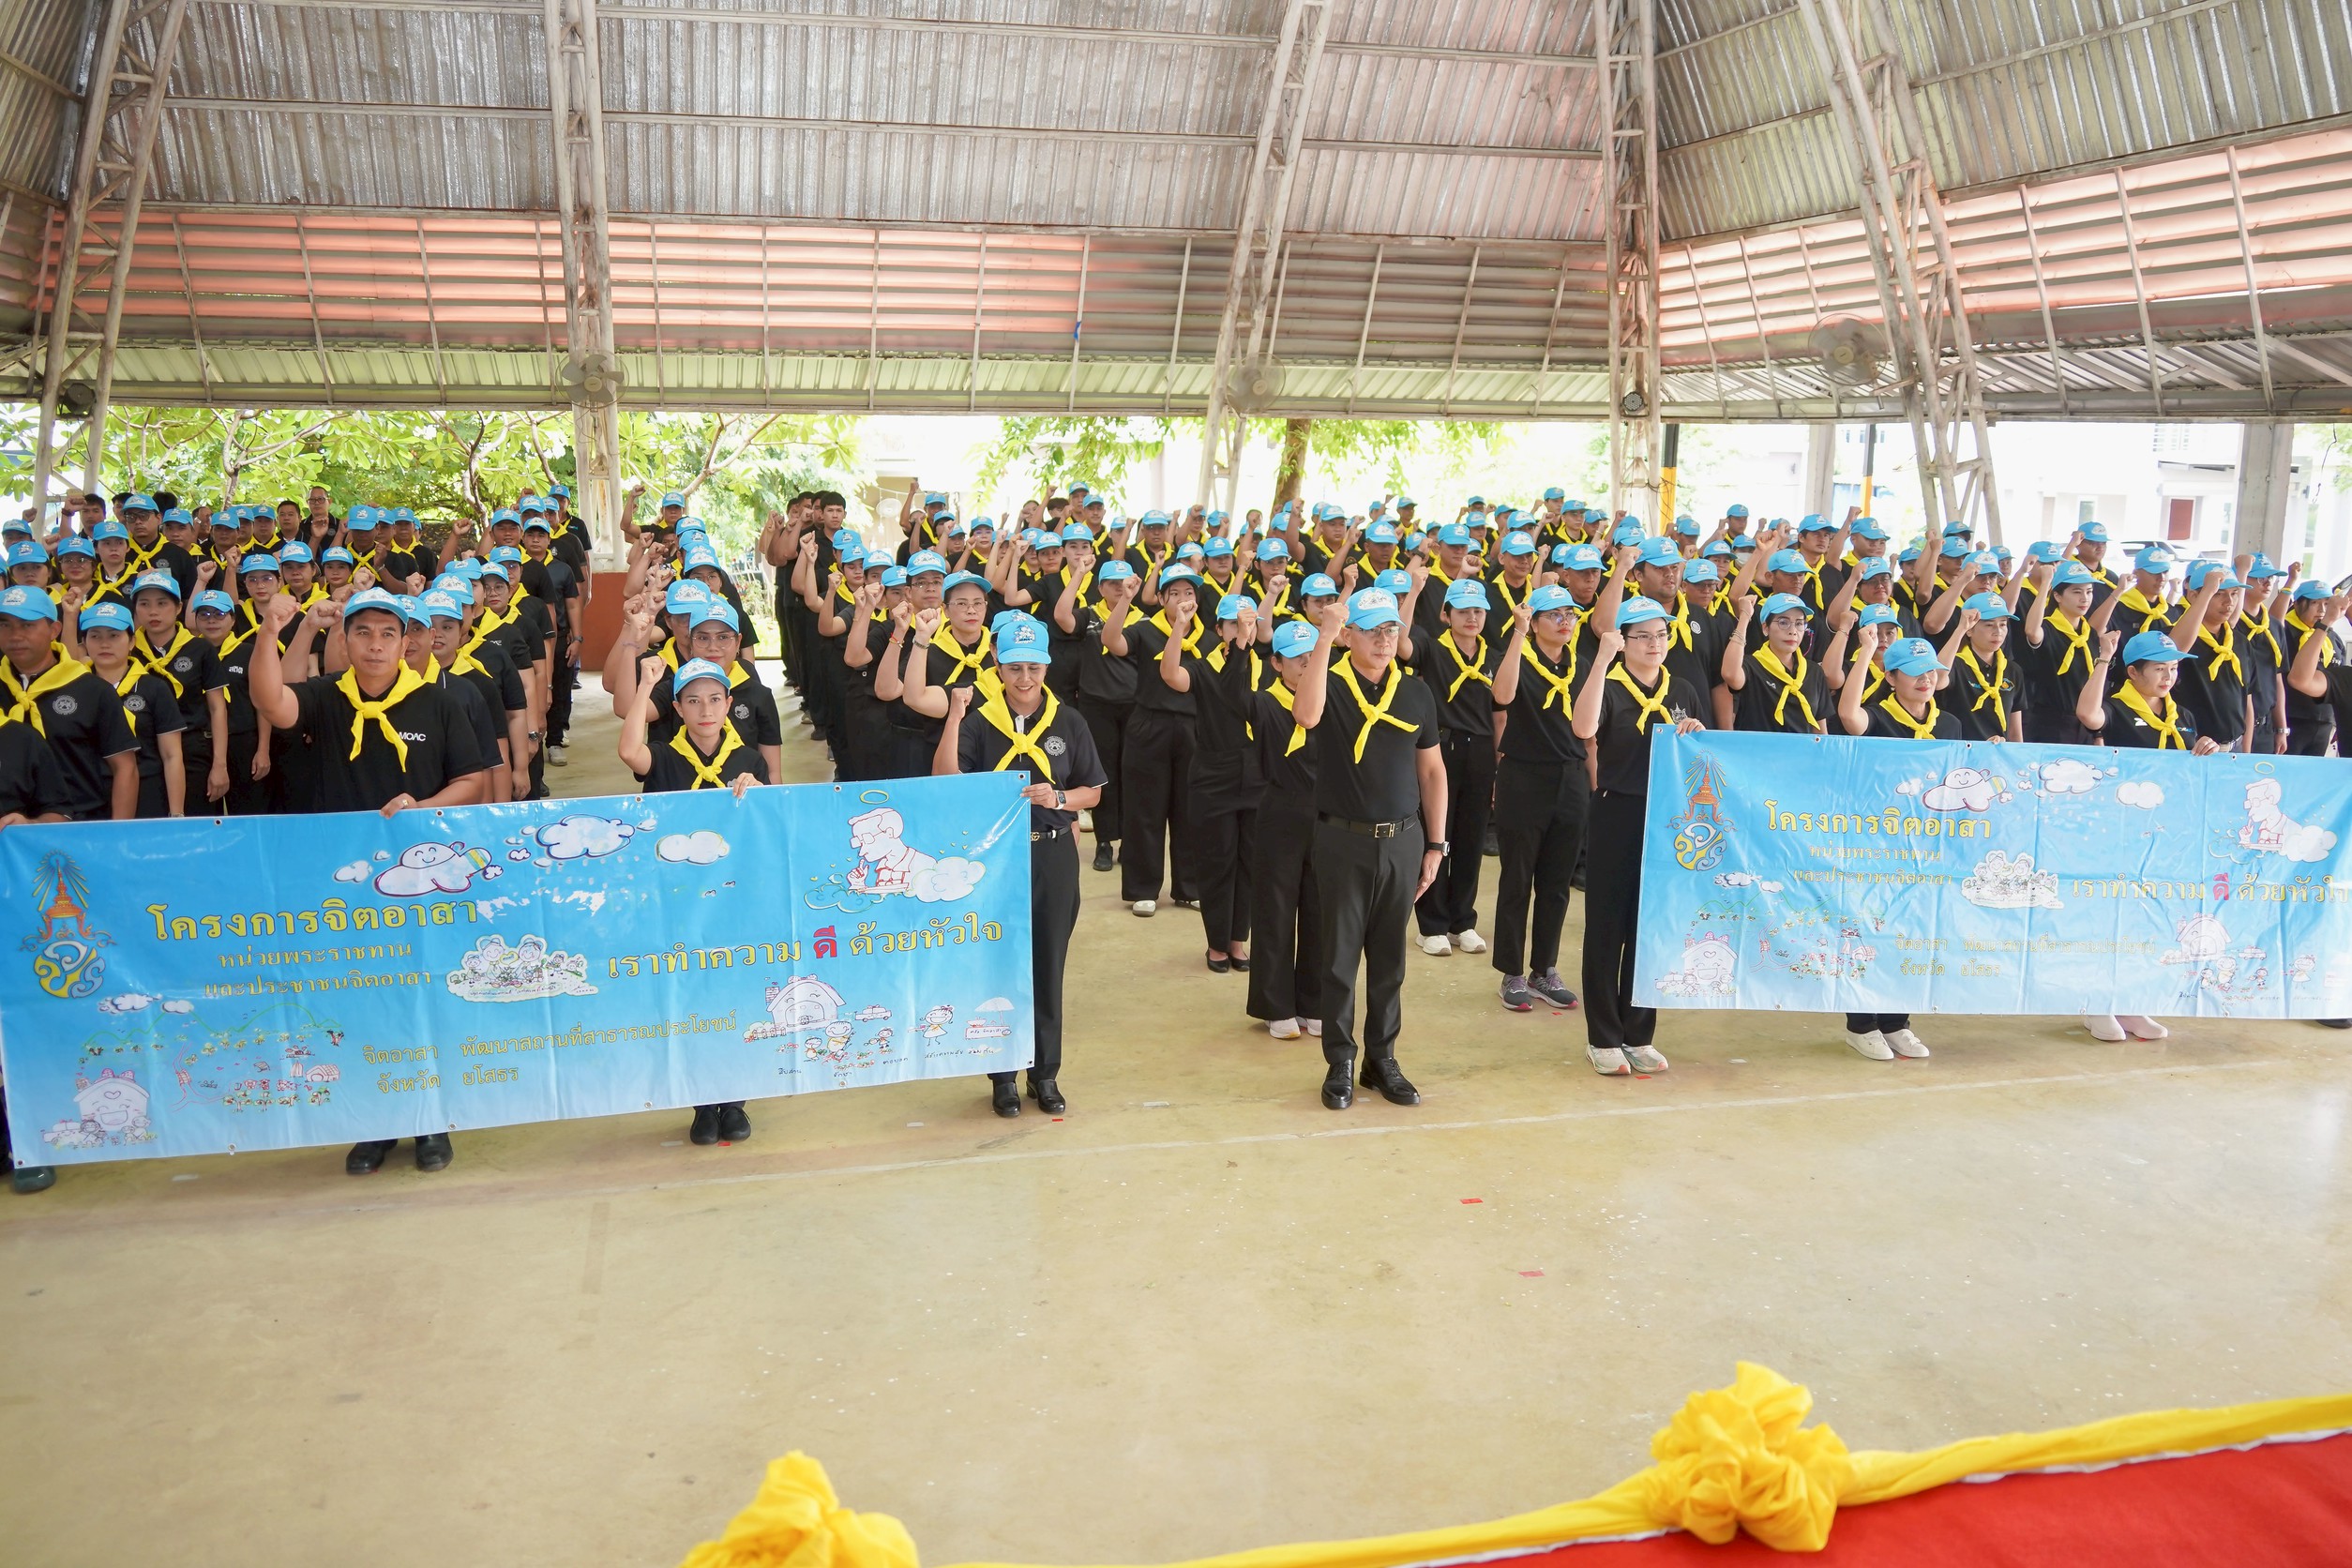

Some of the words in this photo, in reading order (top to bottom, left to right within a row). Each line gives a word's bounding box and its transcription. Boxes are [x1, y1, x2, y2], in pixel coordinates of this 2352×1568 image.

[399, 731, 427, 742] MOAC
[1764, 799, 1992, 838] โครงการจิตอาสา
[1809, 839, 1941, 862] หน่วยพระราชทาน
[1793, 866, 1952, 885] และประชาชนจิตอาสา
[2072, 873, 2205, 899] เราทำความ
[2212, 872, 2230, 901] ดี
[2237, 872, 2349, 903] ด้วยหัวใจ
[145, 897, 479, 942] โครงการจิตอาสา
[218, 942, 413, 969] หน่วยพระราชทาน
[608, 941, 802, 979] เราทำความ
[813, 925, 837, 959] ดี
[849, 911, 1003, 957] ด้วยหัวใจ
[1894, 932, 1949, 951] จิตอาสา
[1900, 957, 1946, 976] จังหวัด
[1960, 959, 2000, 976] ยโสธร
[204, 969, 431, 999] และประชาชนจิตอาสา
[362, 1044, 440, 1065] จิตอาสา
[460, 1009, 738, 1058] พัฒนาสถานที่สาธารณประโยชน์
[377, 1068, 441, 1093] จังหวัด
[462, 1063, 519, 1086] ยโสธร
